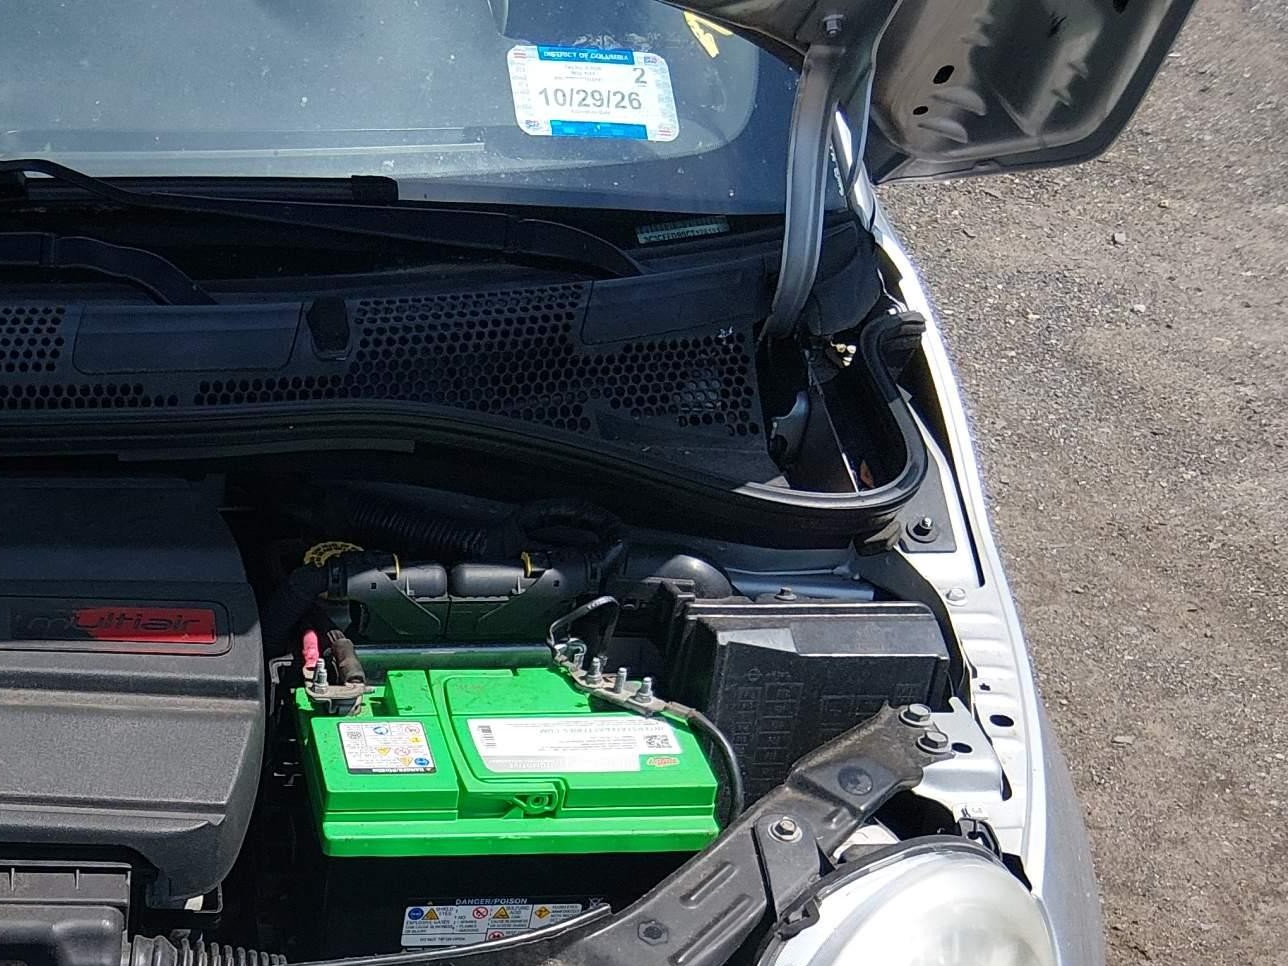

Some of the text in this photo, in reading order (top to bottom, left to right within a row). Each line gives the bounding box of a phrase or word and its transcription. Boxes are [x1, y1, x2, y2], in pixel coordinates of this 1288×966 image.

[632, 67, 648, 85] 2
[538, 87, 643, 110] 10/29/26
[24, 611, 202, 634] multiair
[455, 897, 528, 905] DANGER/POISON
